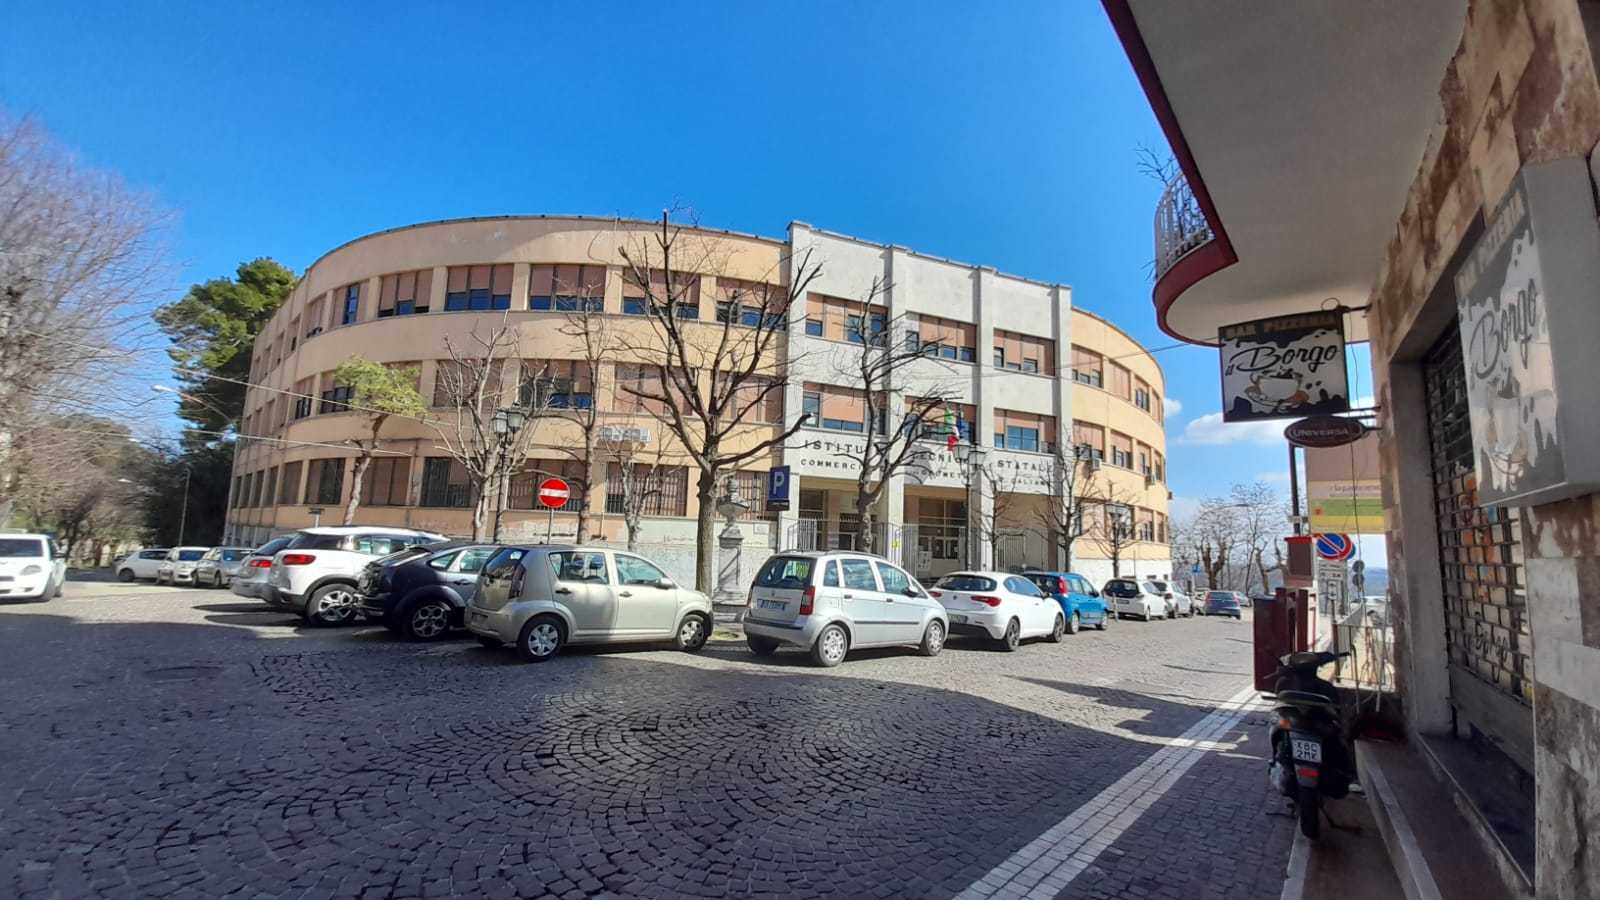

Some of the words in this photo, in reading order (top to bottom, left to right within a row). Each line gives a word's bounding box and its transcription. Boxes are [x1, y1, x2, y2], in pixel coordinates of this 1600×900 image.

[1470, 278, 1538, 380] Borgo
[1229, 344, 1338, 373] Borgo
[804, 439, 866, 454] ISTITU
[773, 471, 785, 495] P
